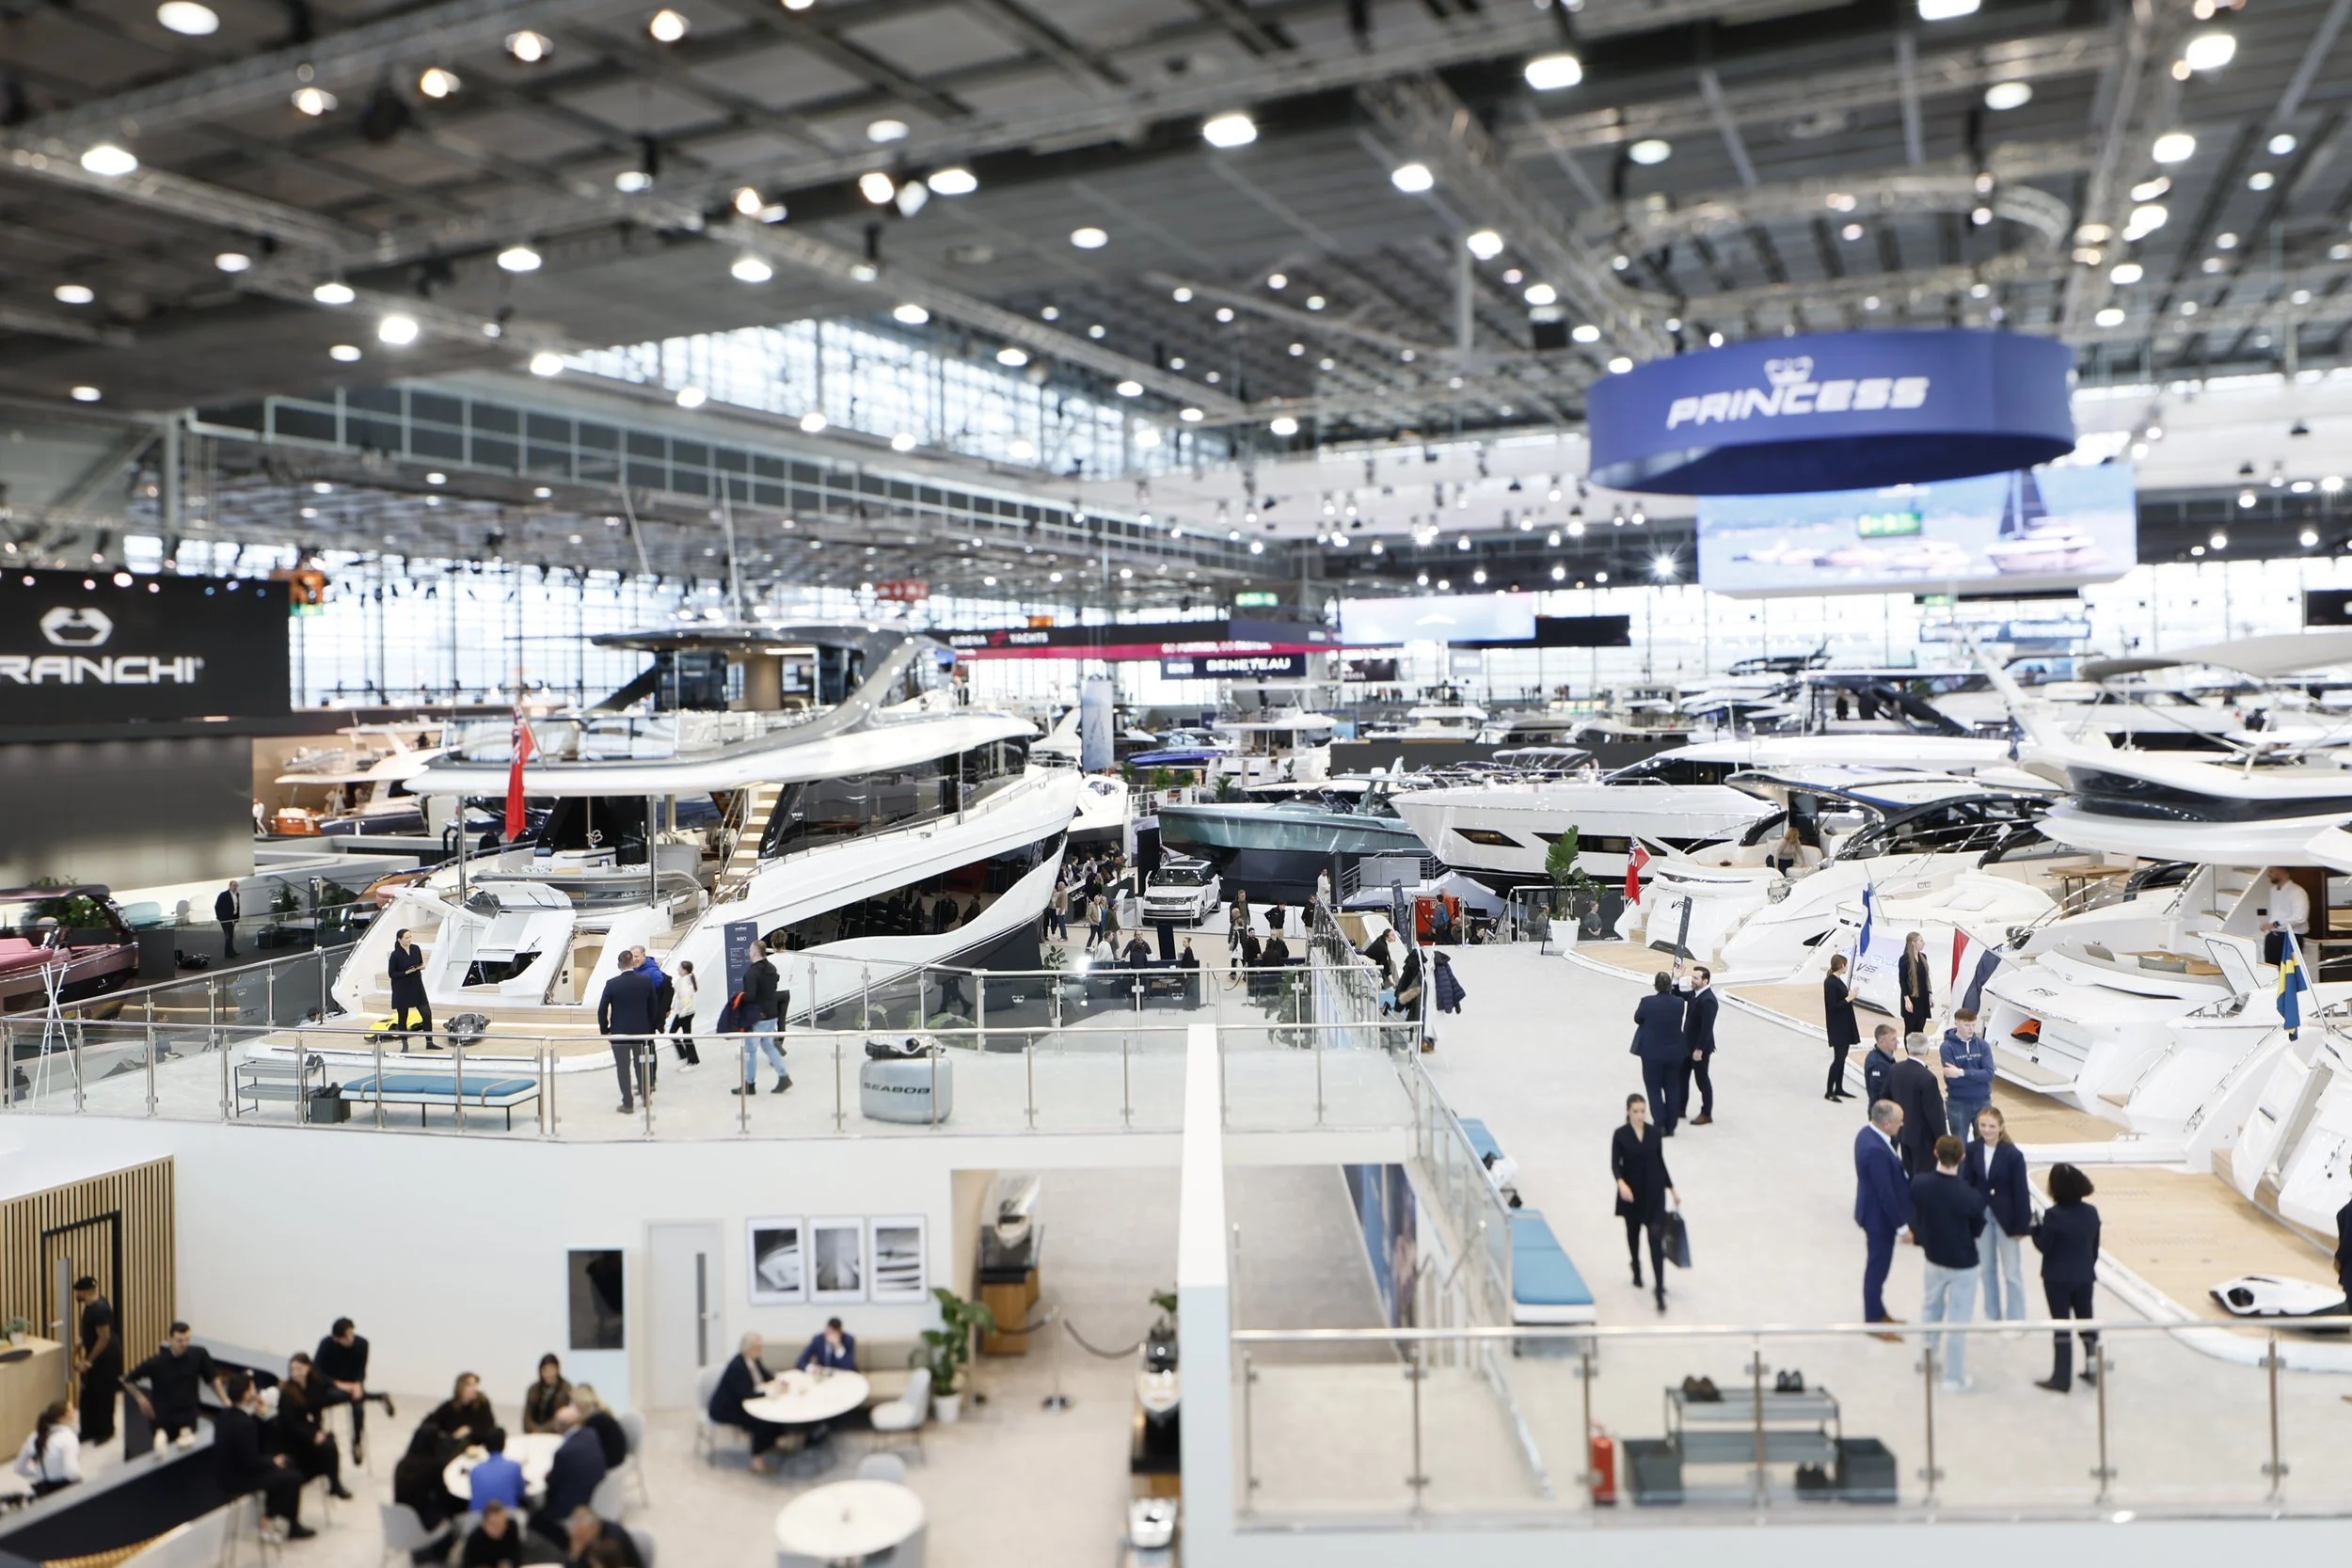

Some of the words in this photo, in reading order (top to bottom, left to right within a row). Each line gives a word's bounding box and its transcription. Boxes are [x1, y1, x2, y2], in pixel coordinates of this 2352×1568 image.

[1666, 376, 1930, 430] PRINCESS
[1009, 631, 1049, 644] YACHTS
[1206, 657, 1292, 672] BENETEAU
[864, 1082, 930, 1095] SEABOB
